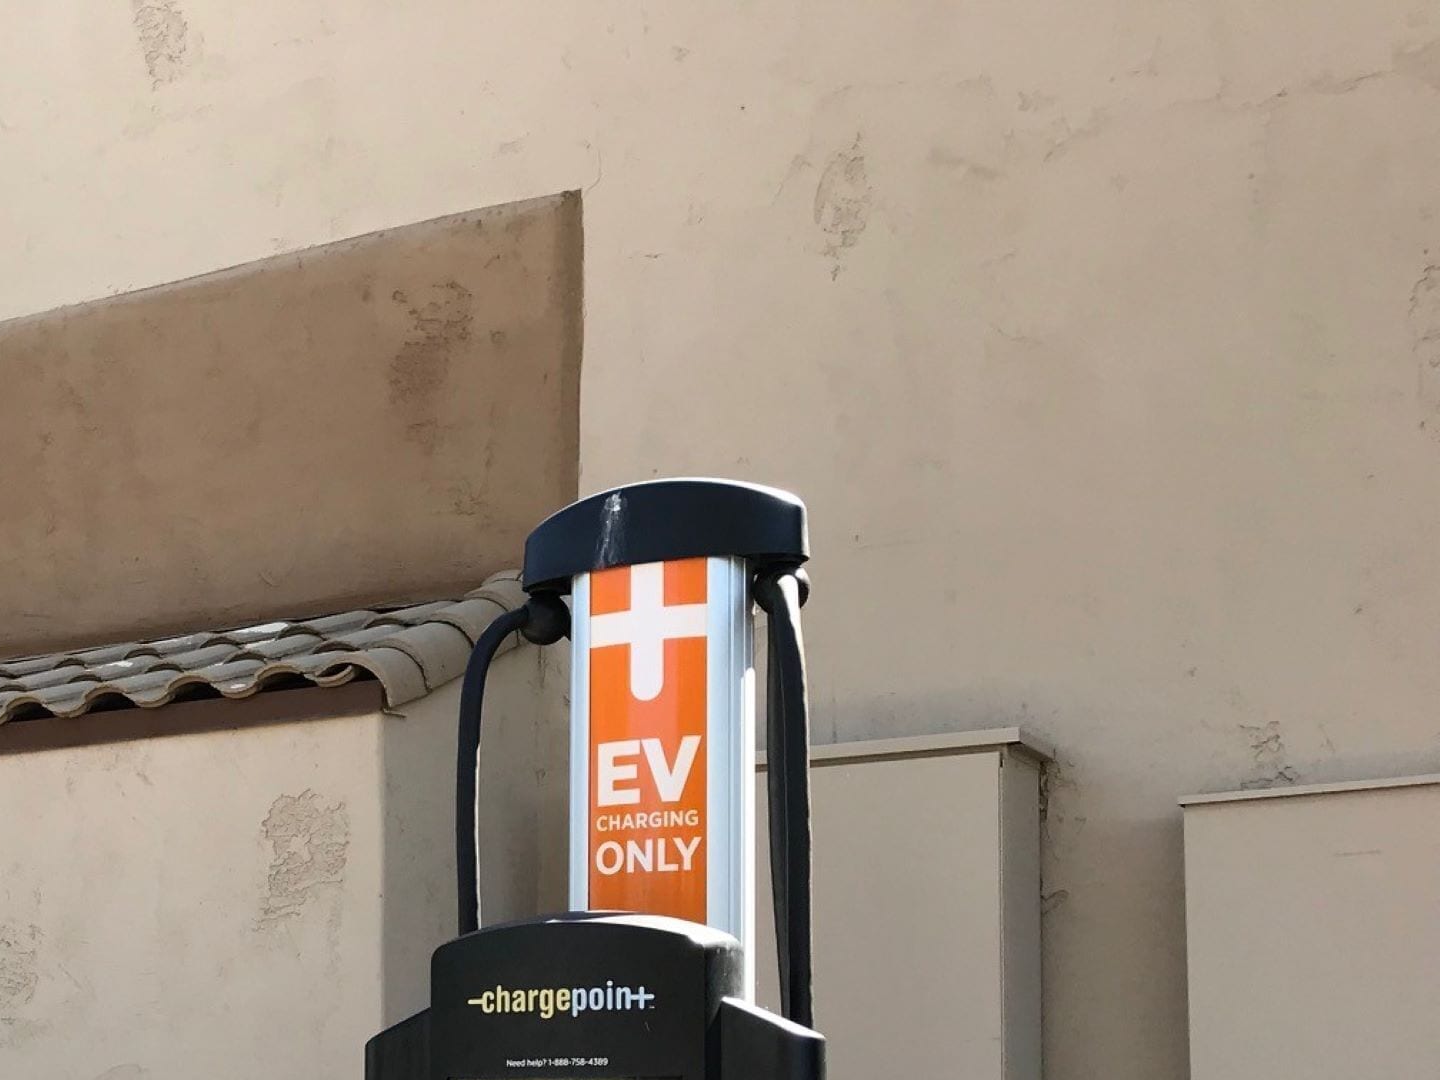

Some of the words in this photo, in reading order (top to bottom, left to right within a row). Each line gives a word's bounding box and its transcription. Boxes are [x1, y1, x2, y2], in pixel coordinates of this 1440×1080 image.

[596, 735, 702, 808] EV
[596, 809, 699, 832] CHARGING
[595, 836, 702, 875] ONLY
[467, 980, 655, 1019] chargepoint
[506, 1059, 526, 1068] Need
[527, 1058, 547, 1068] help?
